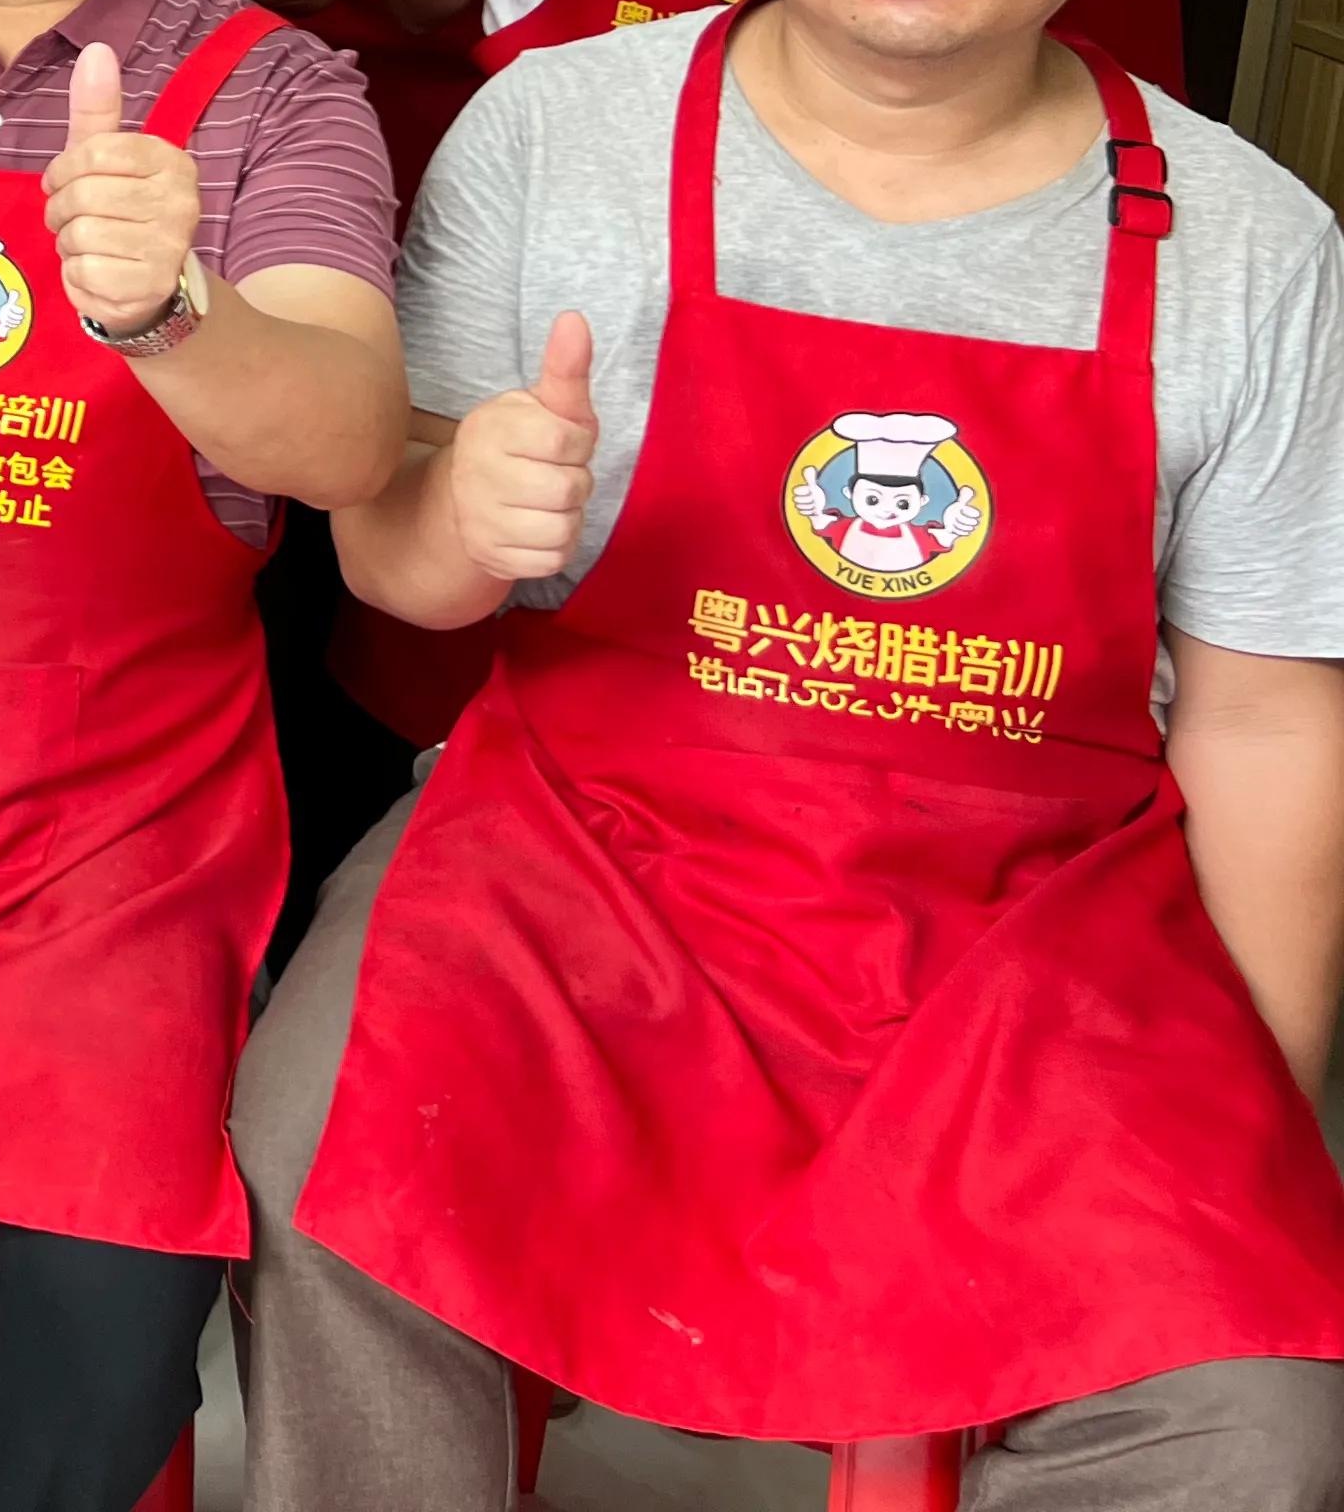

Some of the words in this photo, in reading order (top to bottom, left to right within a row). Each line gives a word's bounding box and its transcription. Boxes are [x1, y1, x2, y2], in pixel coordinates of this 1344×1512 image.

[833, 560, 875, 591] YUE
[880, 569, 934, 594] XING
[687, 588, 1064, 701] 粤兴烧腊培训
